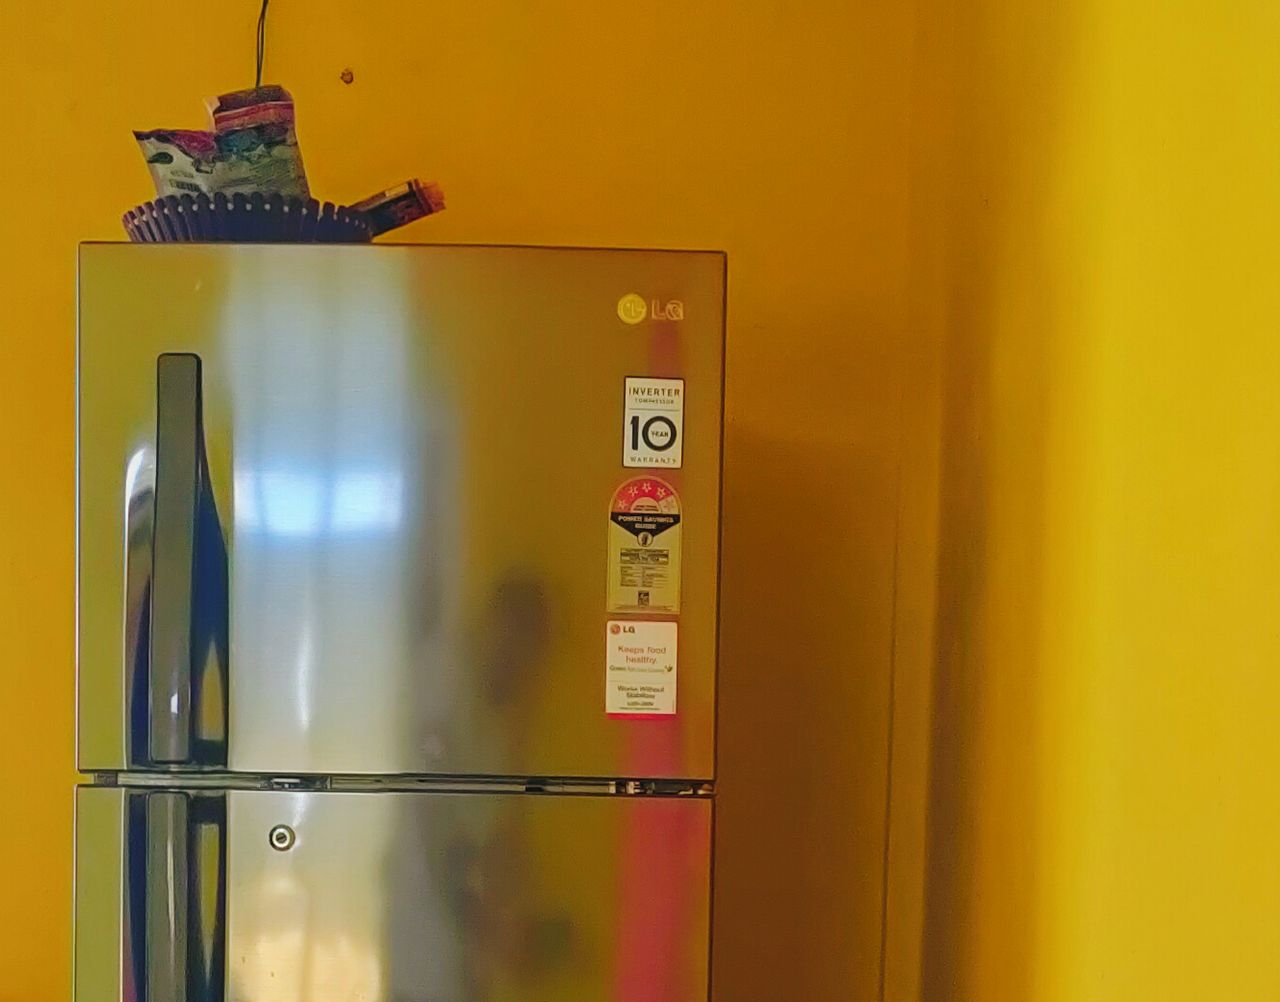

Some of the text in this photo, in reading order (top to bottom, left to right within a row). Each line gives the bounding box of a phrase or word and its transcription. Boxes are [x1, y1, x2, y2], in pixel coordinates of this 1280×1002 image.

[652, 300, 683, 320] LG
[628, 387, 680, 397] INVERTER
[630, 415, 677, 452] 10
[618, 646, 667, 654] Keeps food
